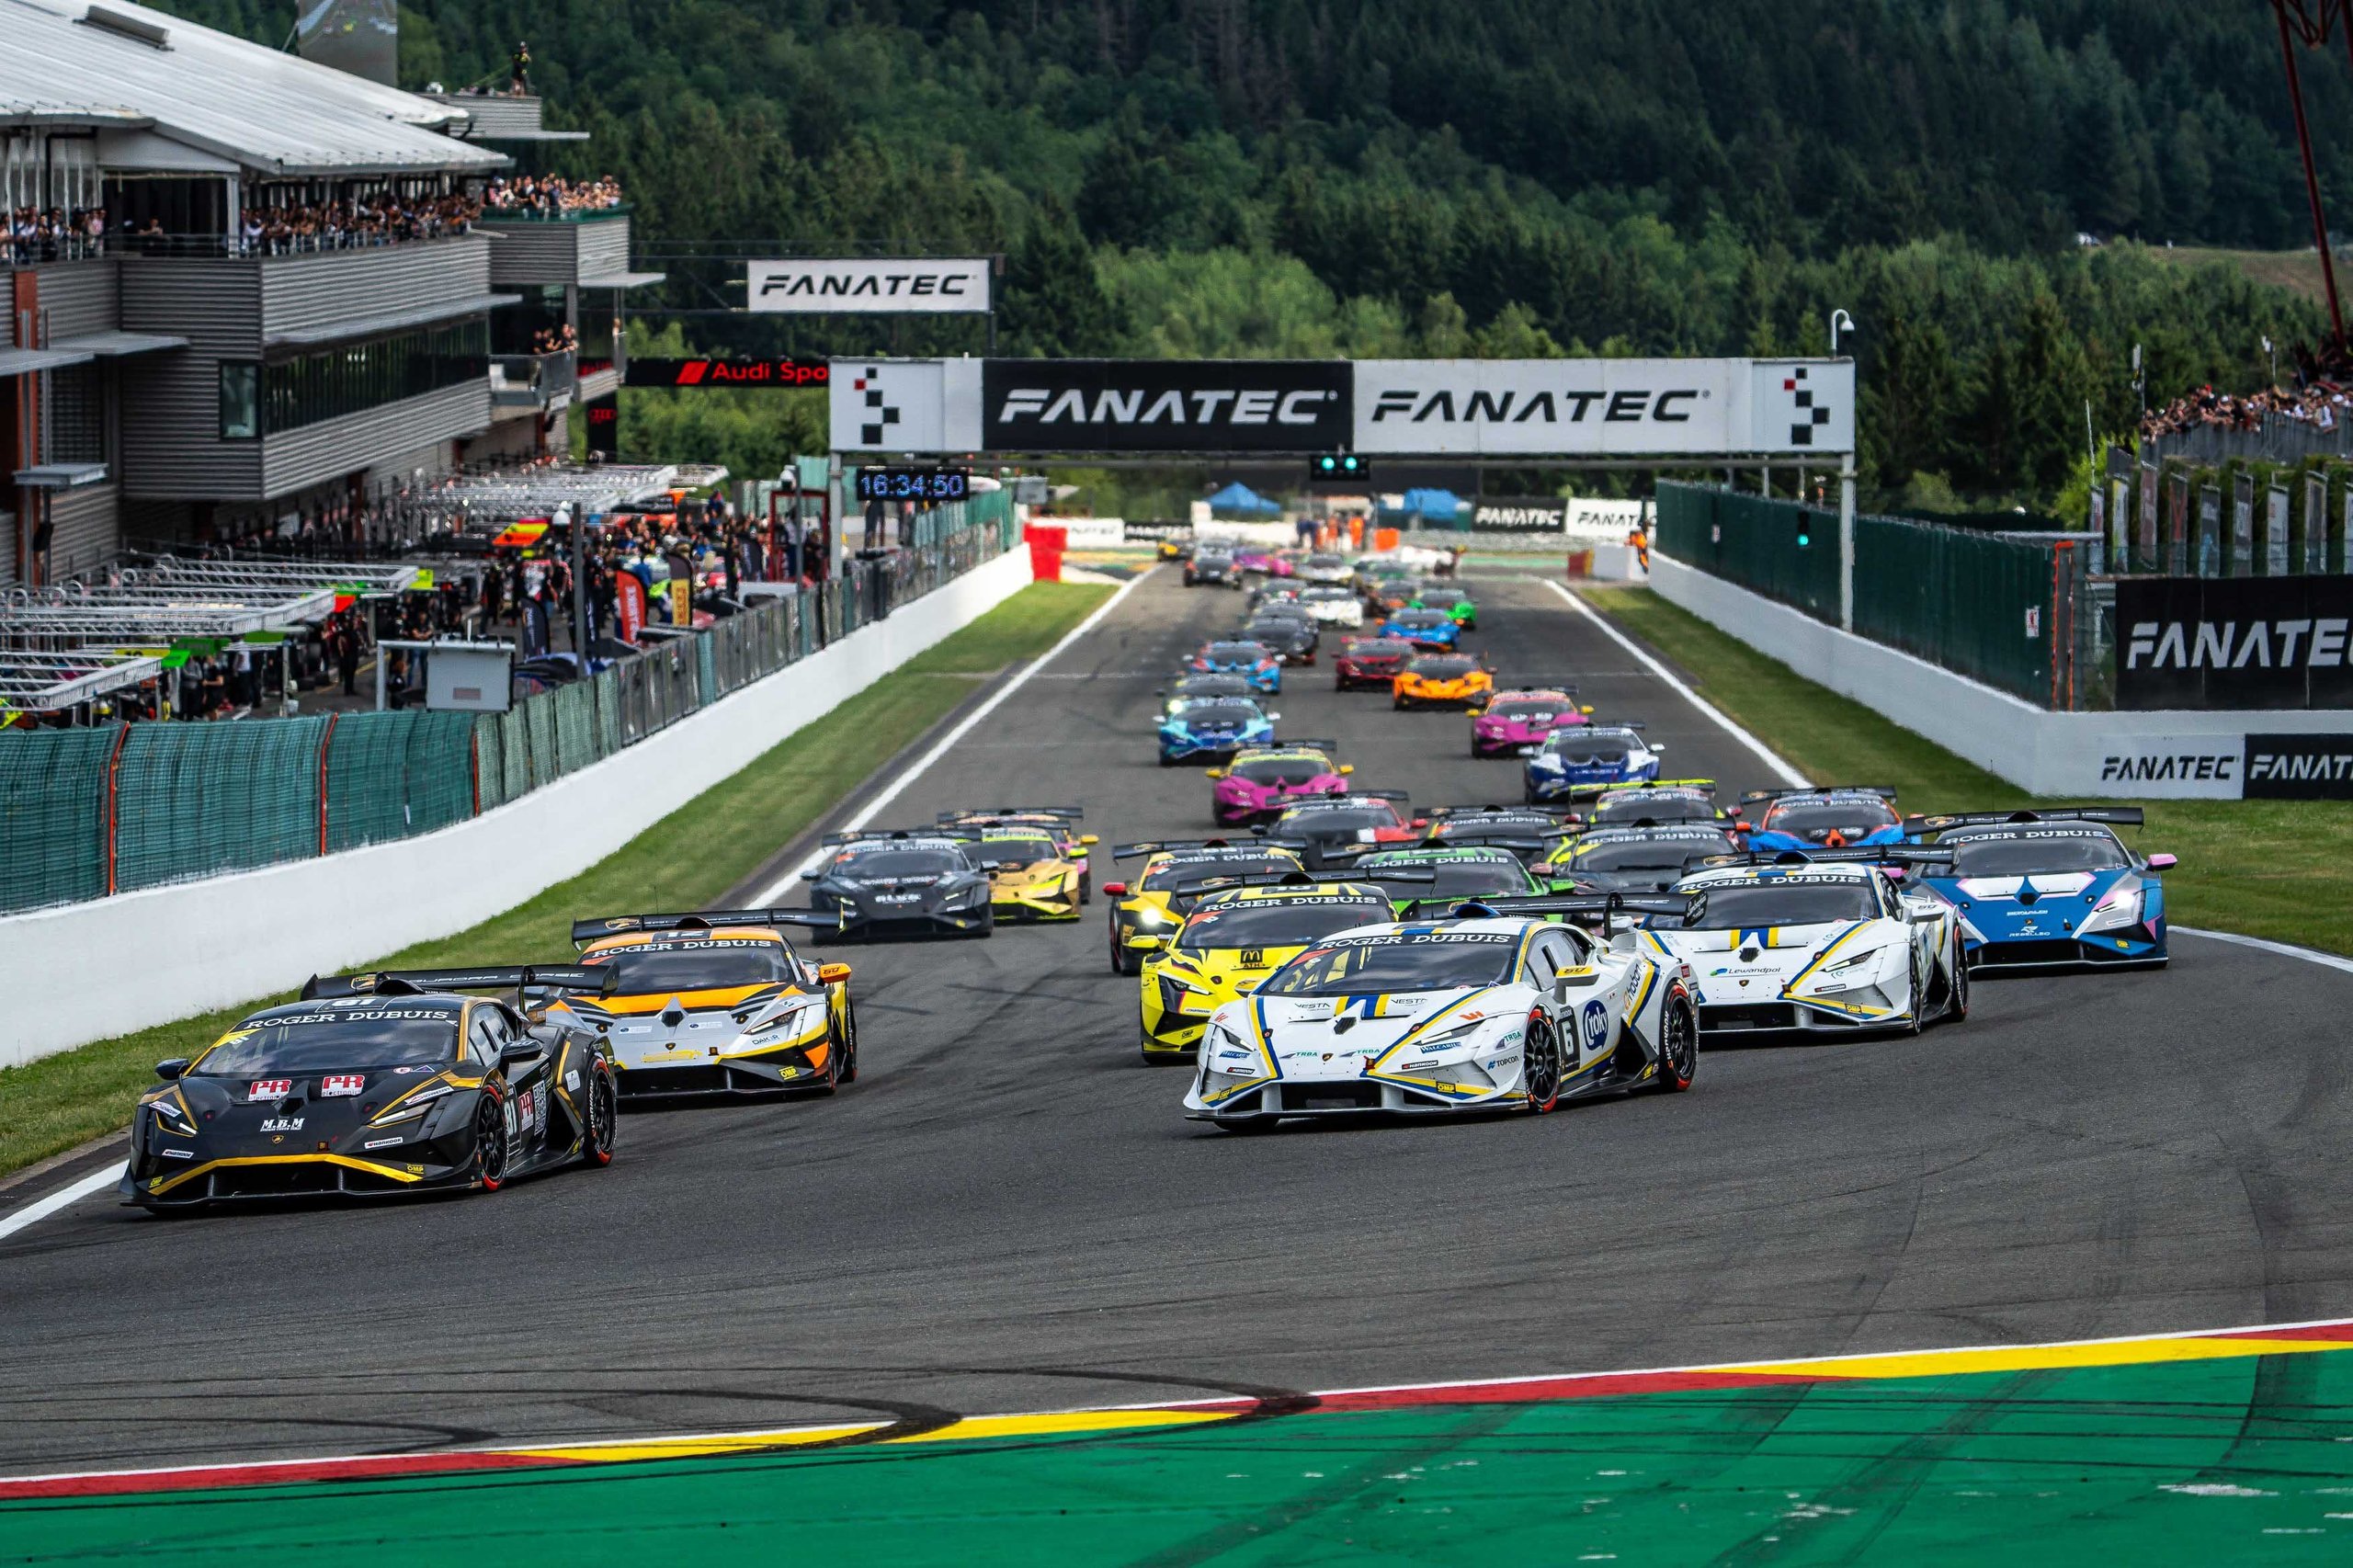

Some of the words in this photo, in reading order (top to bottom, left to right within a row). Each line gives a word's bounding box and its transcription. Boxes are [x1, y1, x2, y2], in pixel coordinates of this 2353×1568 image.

[760, 275, 969, 295] FANATEC
[711, 361, 770, 380] Audi
[998, 389, 1326, 424] FANATEC
[1371, 390, 1699, 423] FANATEC
[861, 473, 964, 496] 16:34:50
[2127, 619, 2353, 669] FANATE
[2101, 756, 2235, 780] FANATEC
[2250, 755, 2353, 780] FANAT
[1944, 832, 2018, 845] ROGER
[2025, 830, 2104, 839] DUBUIS
[1678, 878, 1761, 892] ROGER
[1770, 875, 1861, 885] DUBUIS
[1203, 899, 1282, 912] ROGER
[1291, 896, 1378, 905] DUBUIS
[592, 943, 674, 958] ROGER
[683, 939, 772, 949] DUBUIS
[1317, 936, 1404, 949] ROGER
[1414, 934, 1511, 944] DUBUIS
[1729, 967, 1781, 975] Lewandpol
[244, 1013, 335, 1029] ROGER
[346, 1011, 449, 1022] DUBUIS
[1584, 1007, 1607, 1047] Croky
[1561, 1020, 1574, 1055] 6
[781, 1067, 797, 1078] OMP
